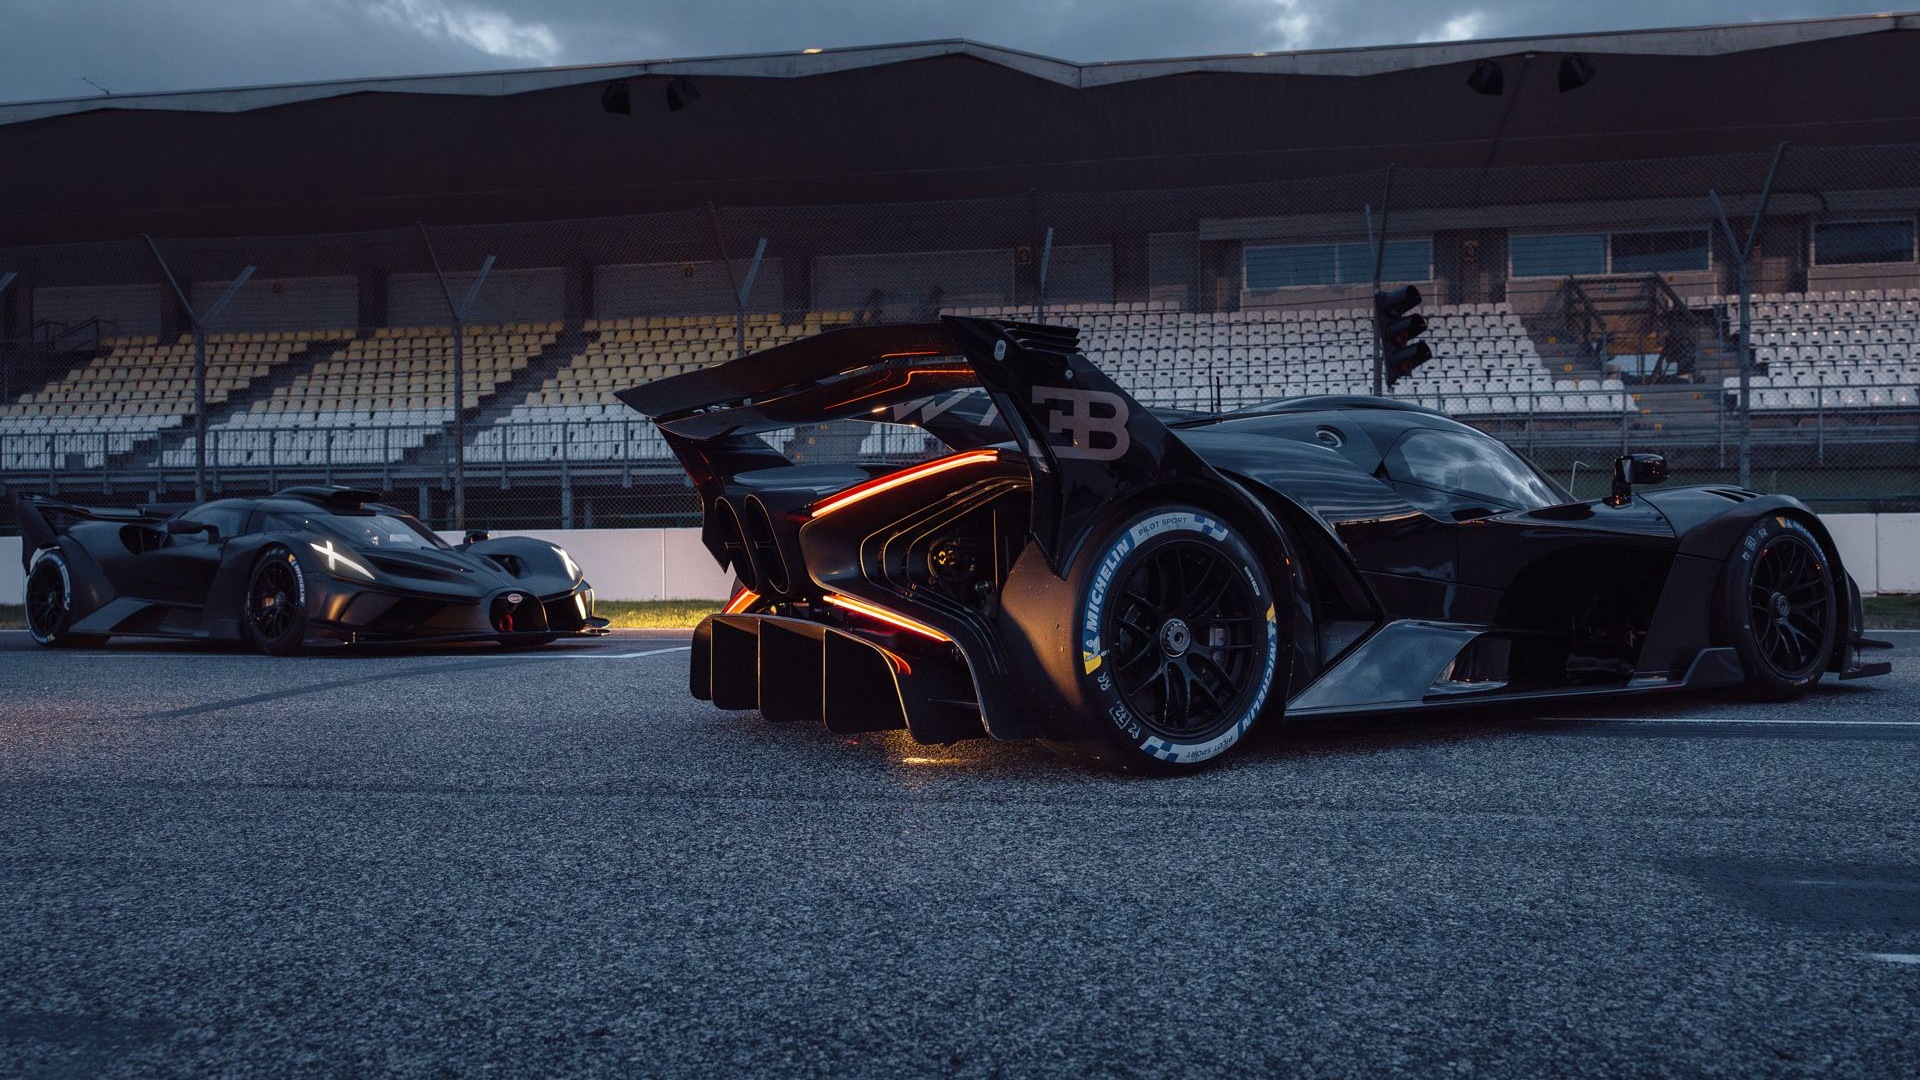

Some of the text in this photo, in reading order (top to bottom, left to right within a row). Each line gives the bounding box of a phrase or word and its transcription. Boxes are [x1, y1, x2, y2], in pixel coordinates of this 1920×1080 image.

[294, 566, 305, 603] MICHELIN
[1085, 517, 1188, 633] MICHELIN PILOT SPORT
[1097, 671, 1112, 691] RR
[1186, 641, 1276, 758] MICHELIN PILOT SPORT
